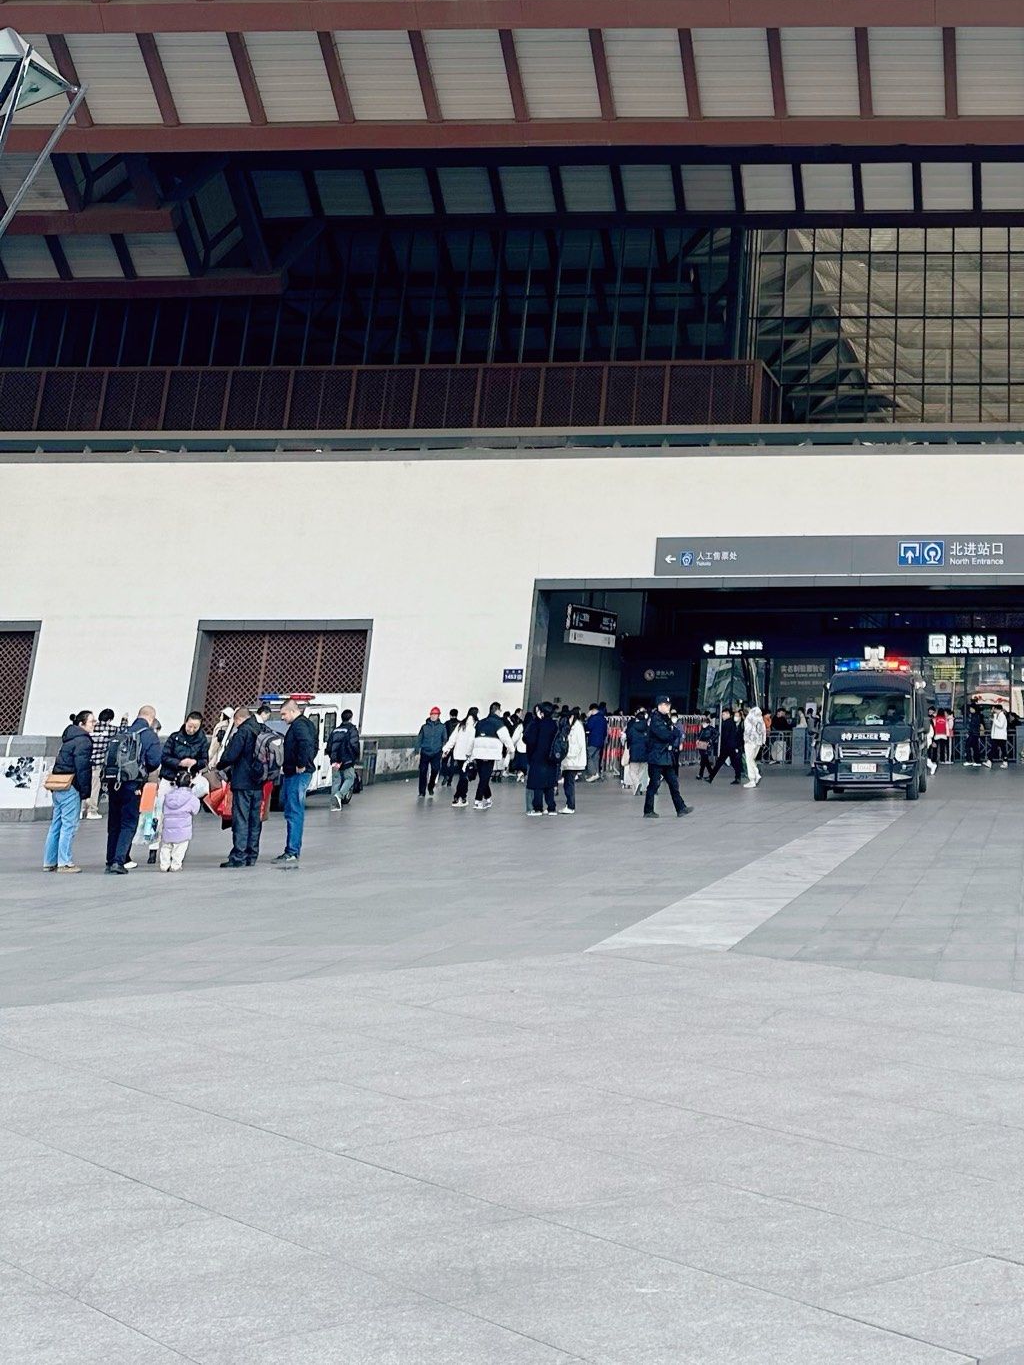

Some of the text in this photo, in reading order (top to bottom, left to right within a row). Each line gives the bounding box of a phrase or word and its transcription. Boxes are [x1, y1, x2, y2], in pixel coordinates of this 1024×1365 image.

[949, 541, 1004, 556] 北进站口
[696, 551, 738, 561] 人工售票处
[949, 557, 1004, 566] North Entrance
[949, 634, 998, 648] 北进站口
[852, 732, 879, 740] POLICE
